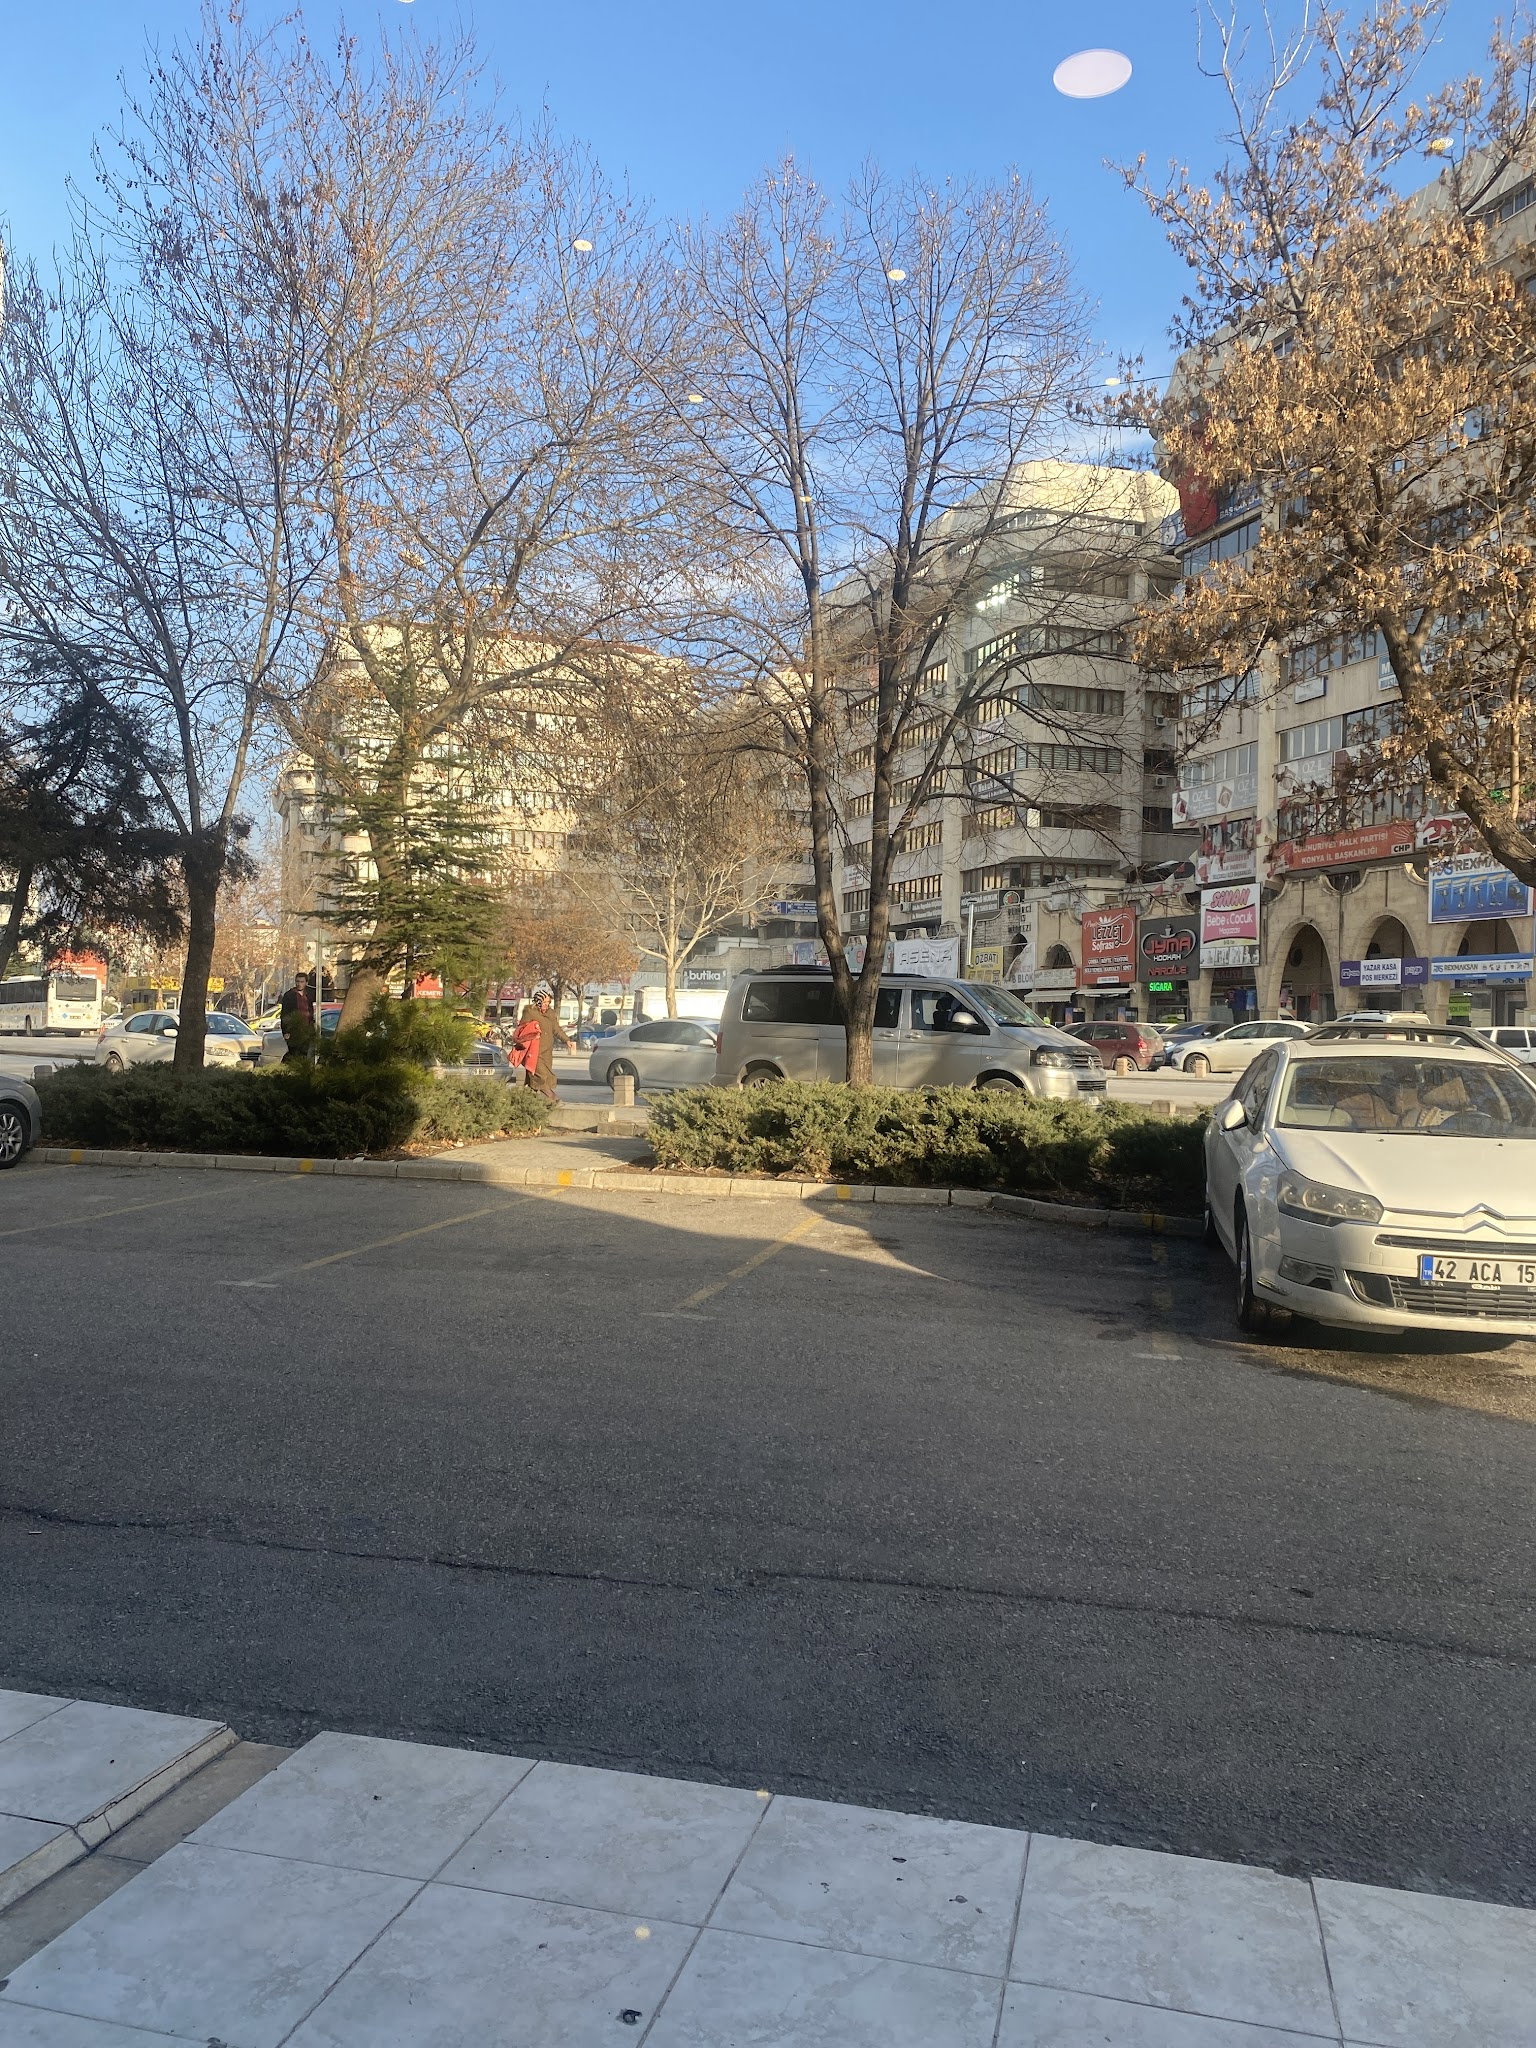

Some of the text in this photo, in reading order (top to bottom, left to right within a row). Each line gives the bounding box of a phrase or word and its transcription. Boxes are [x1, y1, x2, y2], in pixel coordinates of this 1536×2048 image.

[1339, 837, 1358, 847] HALK
[1393, 844, 1411, 853] CHP
[1301, 855, 1325, 864] KONYA
[1206, 914, 1226, 927] Bebe
[1363, 963, 1397, 972] YAZAR KASA
[688, 969, 721, 981] butika
[1434, 1259, 1536, 1283] 42 ACA 15
